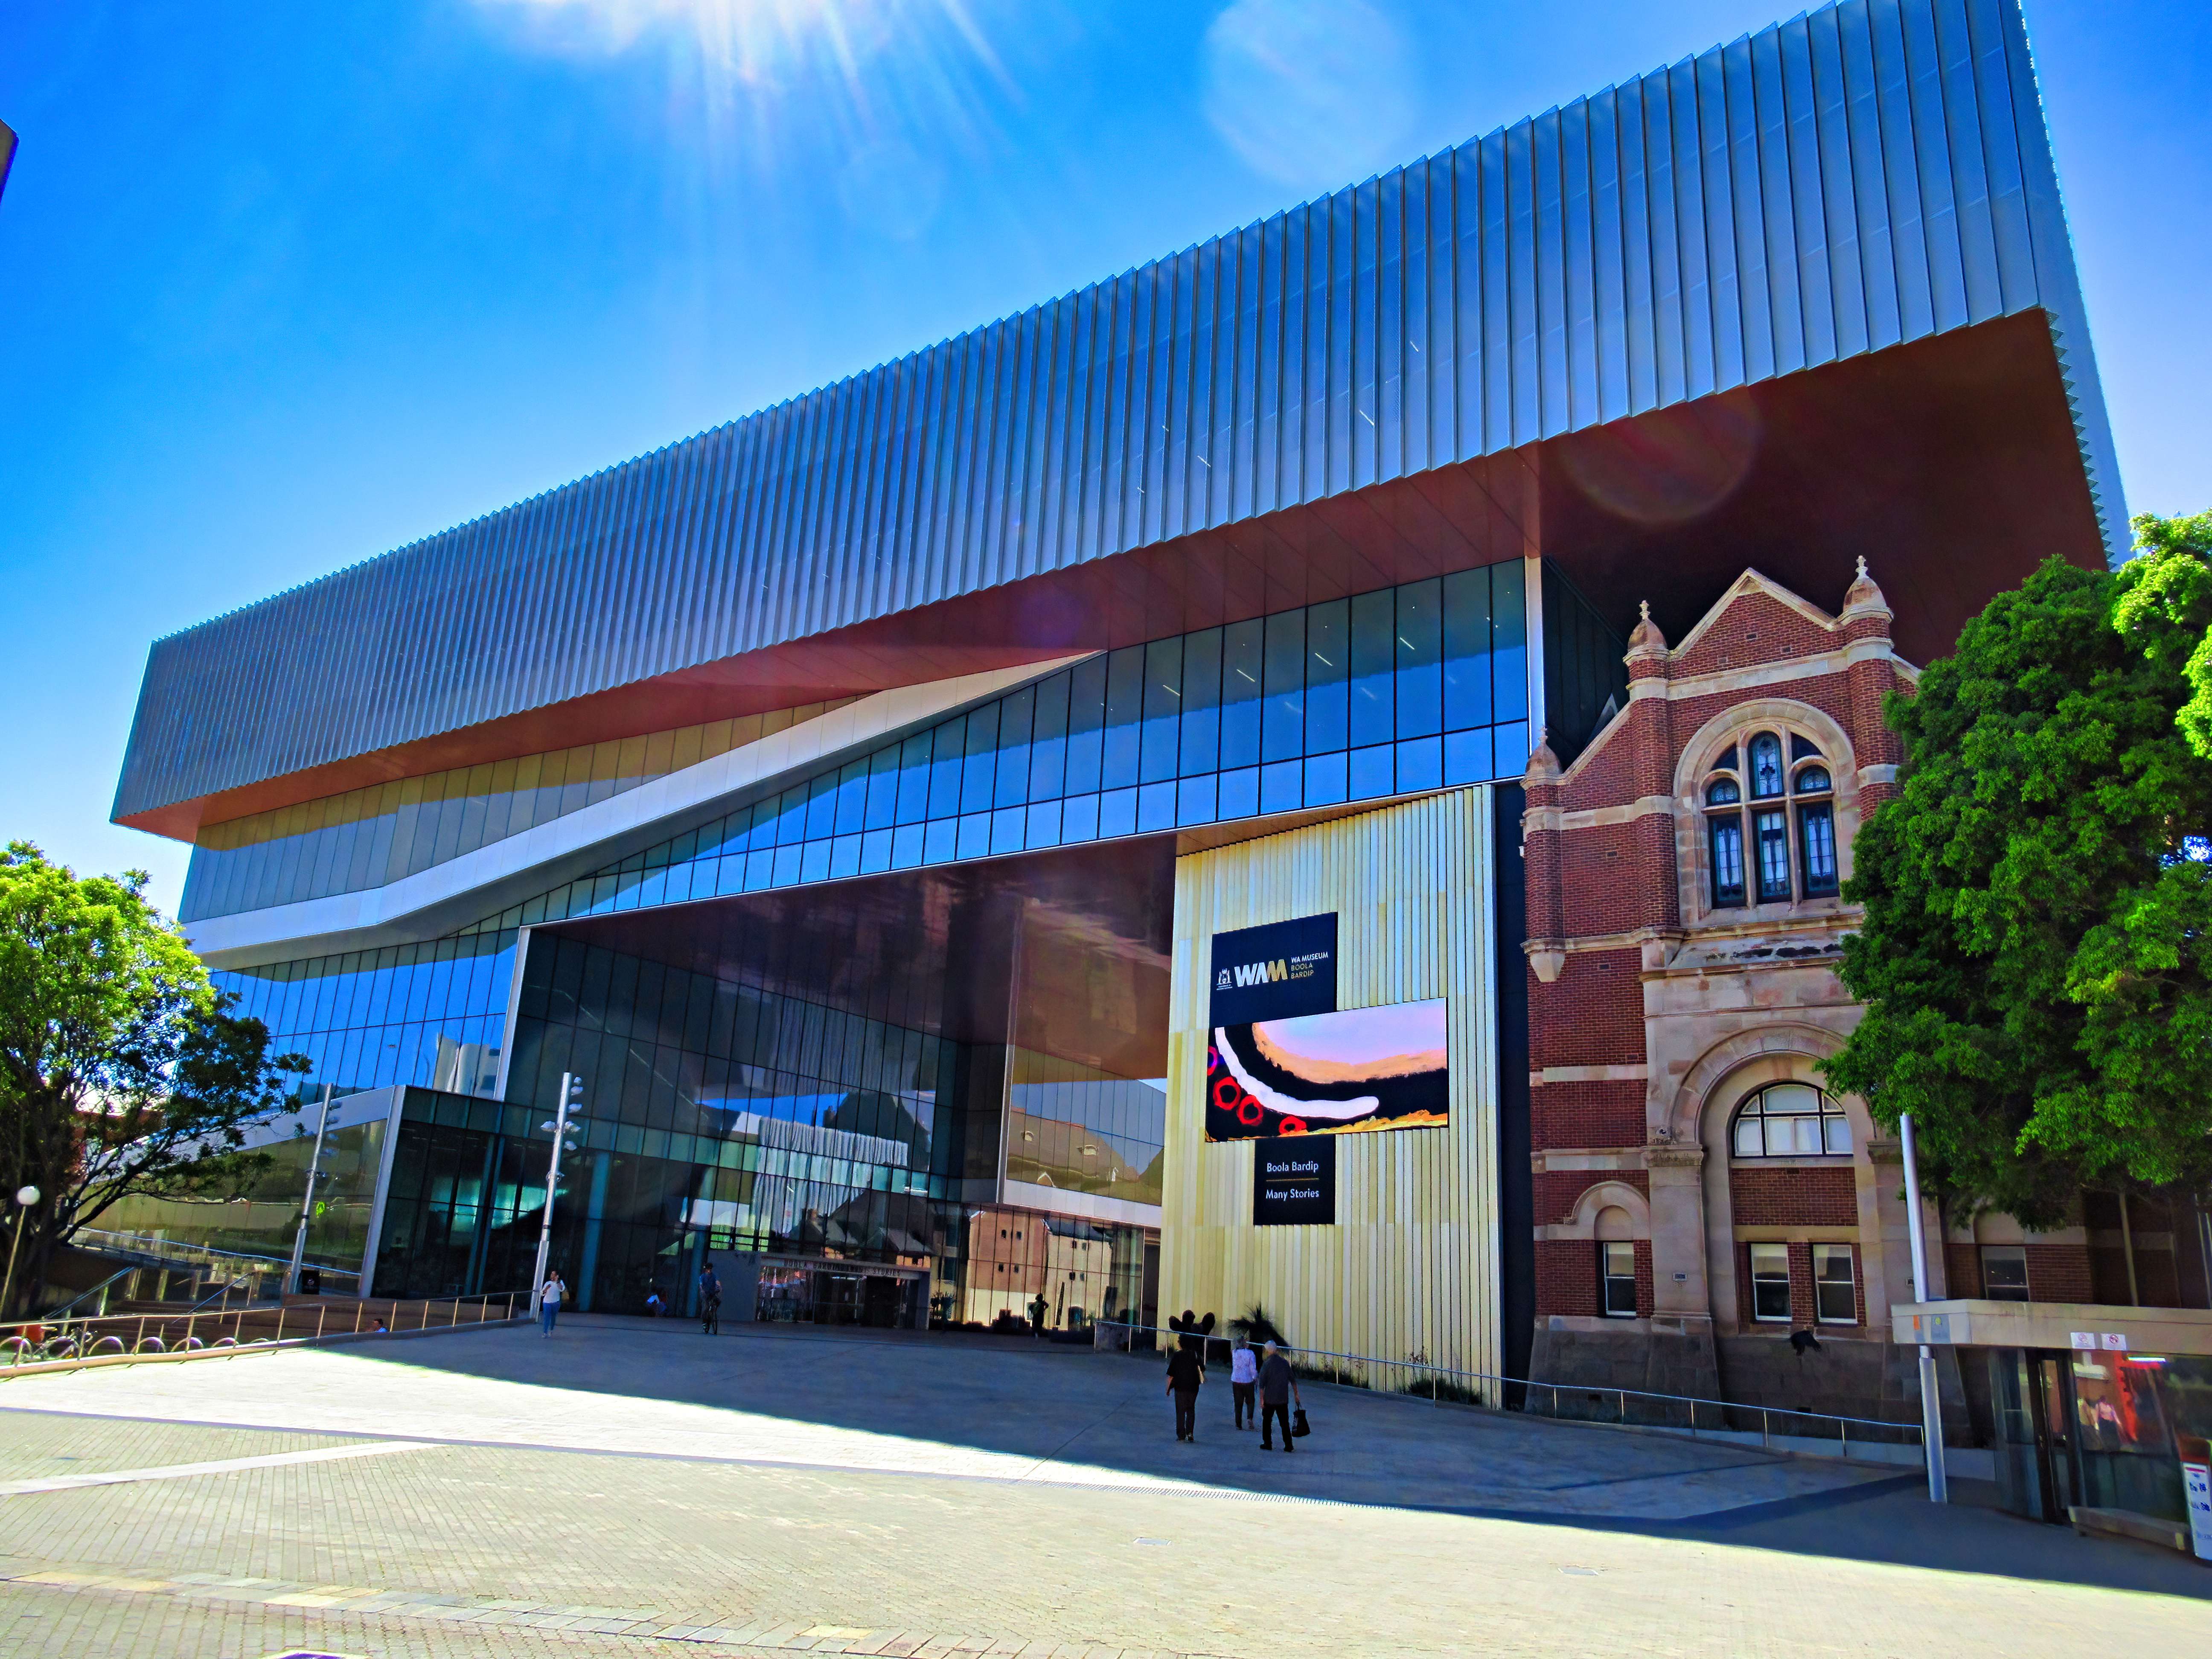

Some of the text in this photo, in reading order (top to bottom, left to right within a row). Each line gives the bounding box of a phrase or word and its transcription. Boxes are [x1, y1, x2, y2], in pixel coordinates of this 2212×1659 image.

[1301, 951, 1328, 961] MUSEUM
[1291, 962, 1313, 971] BOOLA
[1234, 959, 1288, 987] WAM
[1291, 970, 1314, 979] BARDIP
[1267, 1161, 1319, 1173] Boola Bardip
[1266, 1188, 1319, 1202] Many Stories
